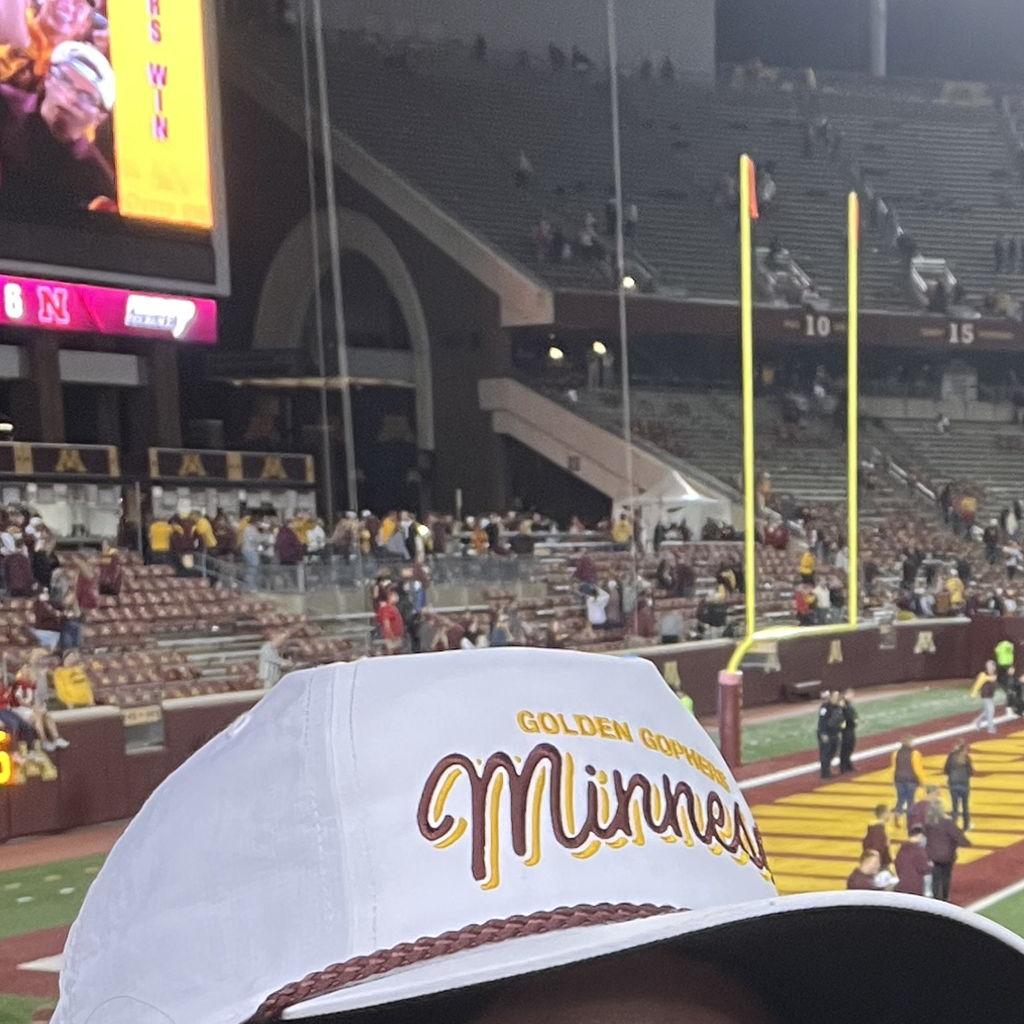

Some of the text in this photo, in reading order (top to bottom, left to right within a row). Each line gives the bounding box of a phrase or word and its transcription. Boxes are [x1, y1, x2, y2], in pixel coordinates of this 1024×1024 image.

[148, 62, 168, 139] WIN
[805, 314, 831, 337] 10
[949, 322, 975, 344] 15
[516, 709, 634, 743] GOLDEN
[416, 742, 774, 889] Minnes
